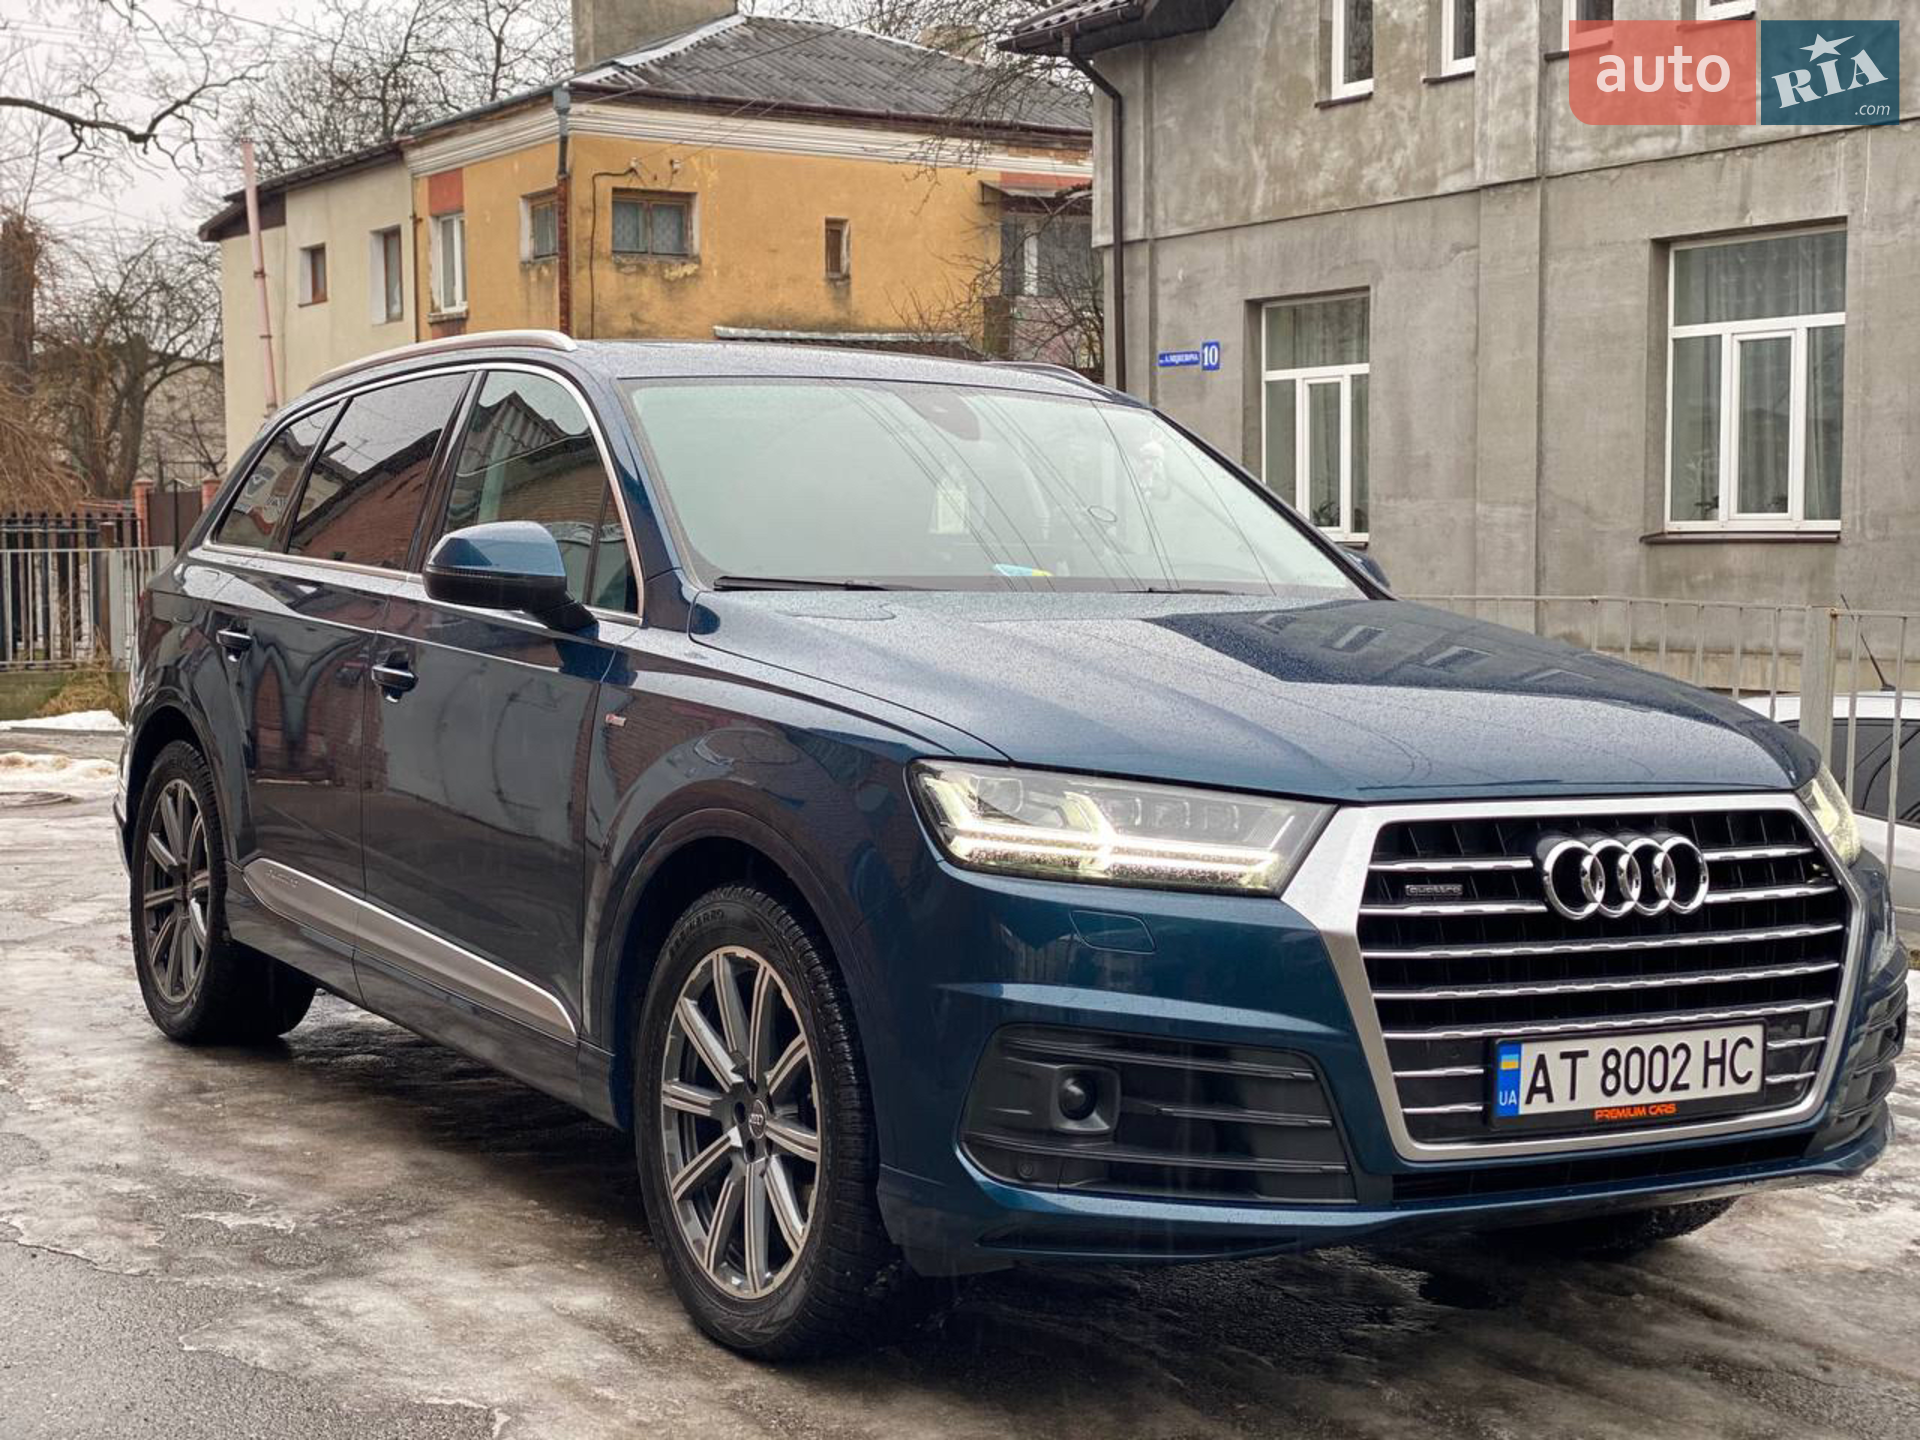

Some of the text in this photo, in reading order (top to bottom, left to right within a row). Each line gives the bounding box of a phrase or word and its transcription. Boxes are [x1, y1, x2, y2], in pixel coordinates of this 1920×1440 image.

[1203, 345, 1219, 366] 10
[1524, 1036, 1755, 1105] AT 8002 HC
[1499, 1089, 1518, 1106] UA
[1594, 1103, 1677, 1121] PREMIUM CARS
